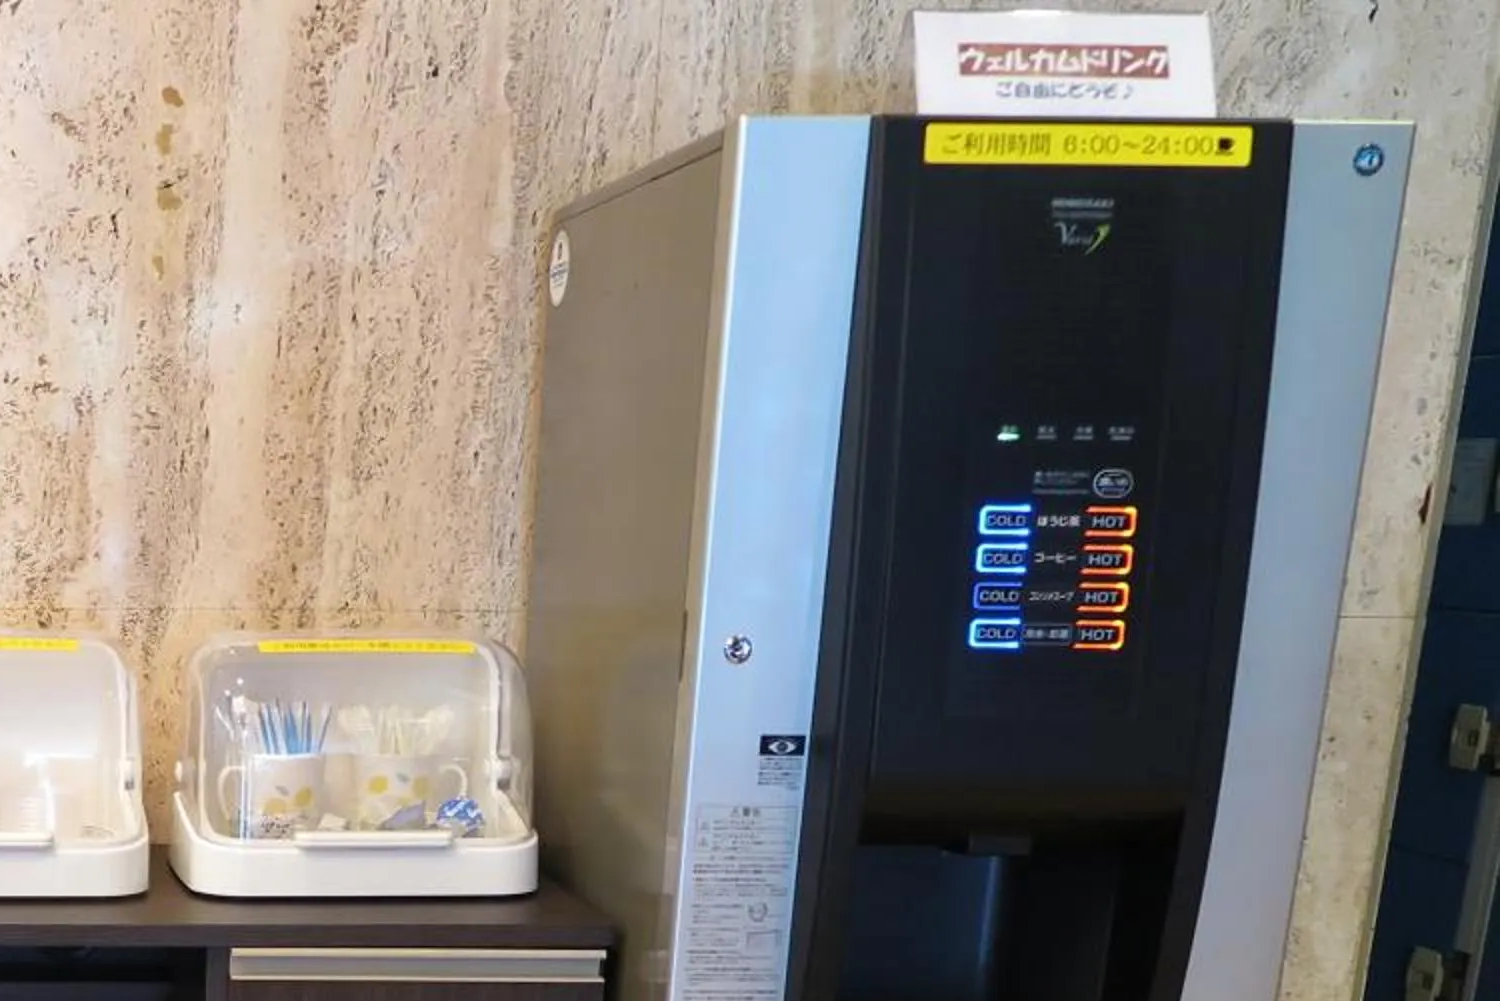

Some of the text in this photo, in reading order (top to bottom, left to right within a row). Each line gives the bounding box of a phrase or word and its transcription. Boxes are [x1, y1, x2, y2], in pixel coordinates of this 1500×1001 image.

[959, 46, 1168, 76] ウェルカムドリンク
[941, 131, 1052, 156] ご利用時間
[986, 514, 1027, 527] COLD
[1091, 515, 1127, 529] HOT
[983, 552, 1023, 565] COLD
[1033, 552, 1077, 565] コーヒー
[1087, 554, 1123, 566] HOT
[979, 590, 1020, 603] COLD
[1084, 591, 1119, 603] HOT
[976, 627, 1017, 640] COLD
[1080, 628, 1116, 641] HOT
